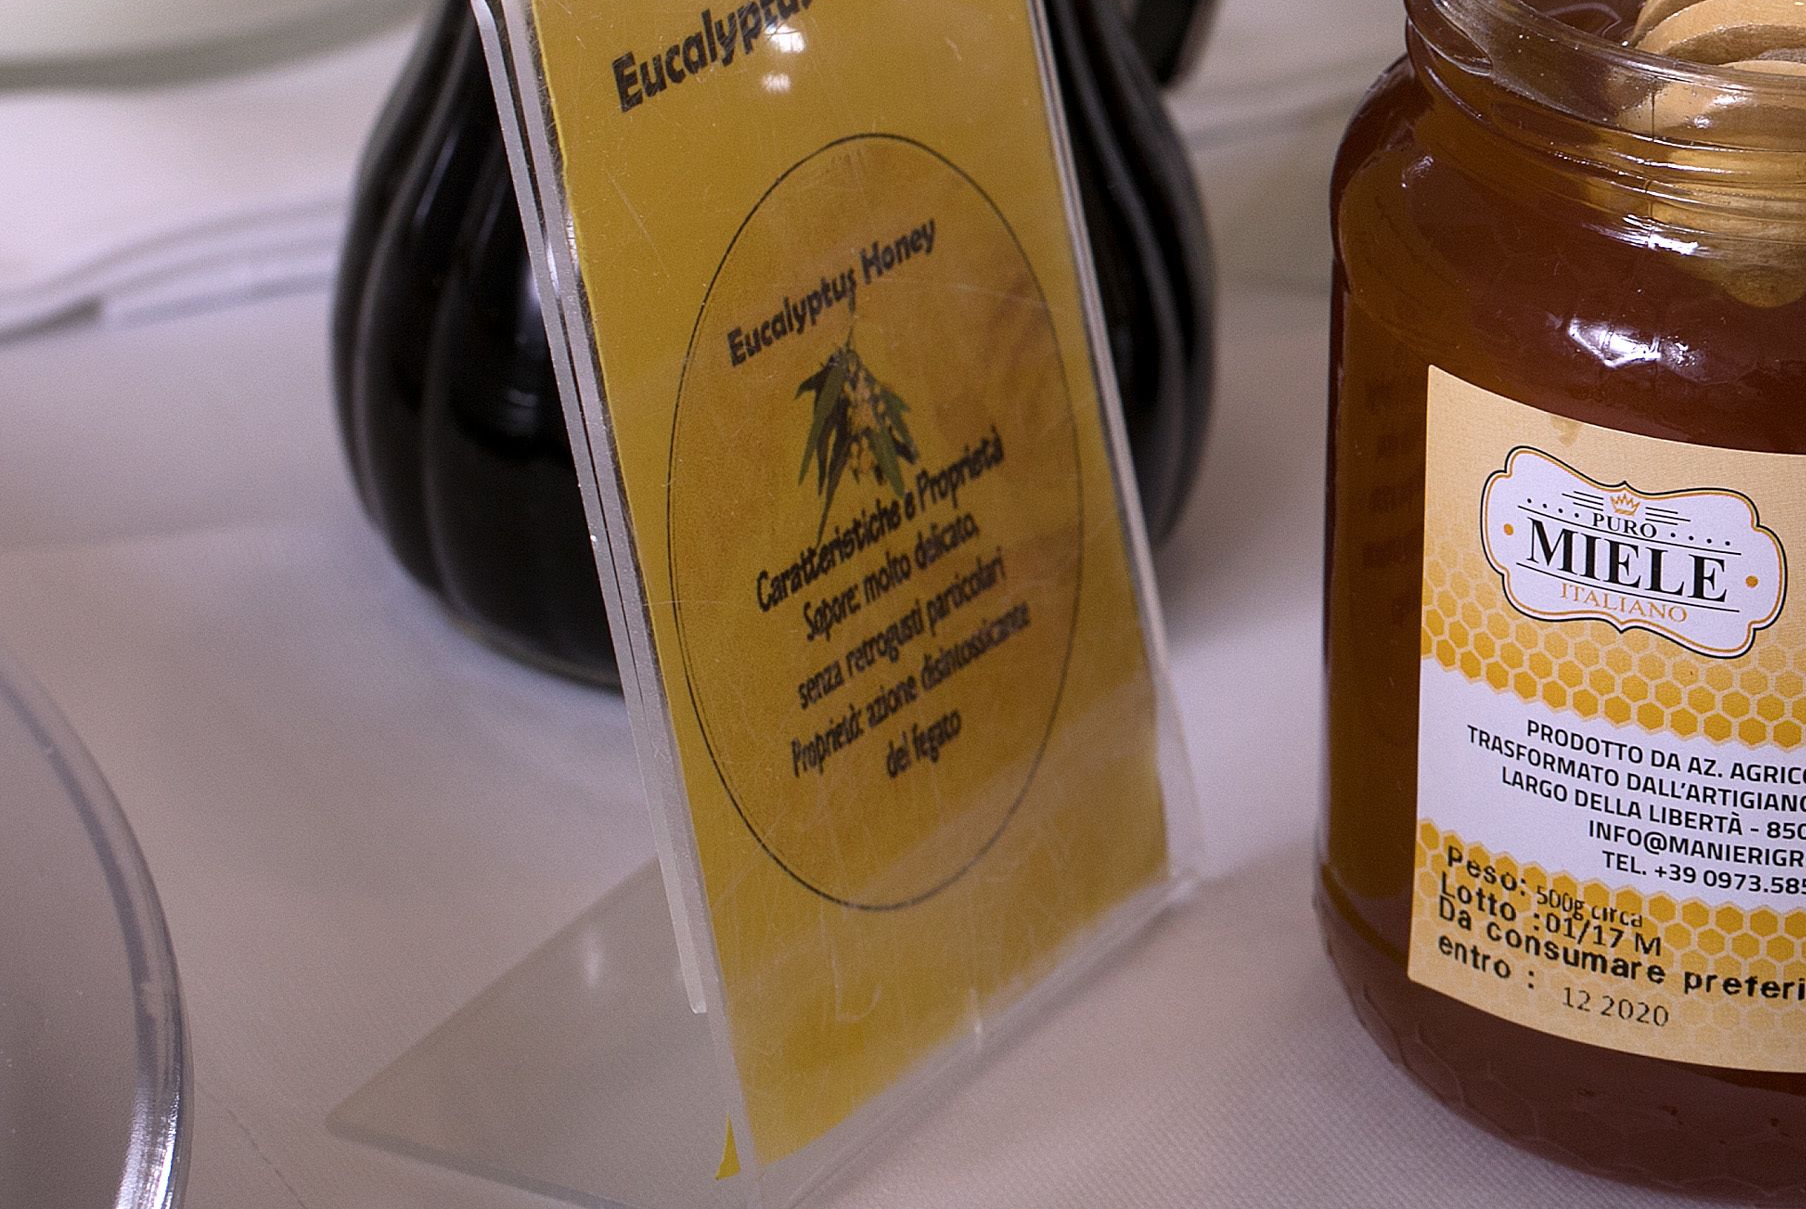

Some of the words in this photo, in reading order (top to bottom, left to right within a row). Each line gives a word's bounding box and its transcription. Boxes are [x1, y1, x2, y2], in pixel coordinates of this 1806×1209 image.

[727, 265, 857, 367] Eucalyptus
[860, 218, 936, 285] Honey
[756, 498, 902, 613] Caratteristiche
[904, 492, 915, 521] e
[916, 424, 1004, 512] Proprietà
[1592, 511, 1658, 539] PURO
[864, 550, 912, 604] molto
[1525, 516, 1730, 603] MIELE
[1559, 582, 1689, 623] ITALIANO
[797, 658, 845, 710] senza
[866, 673, 919, 730] azione
[886, 731, 913, 779] del
[912, 707, 963, 764] fegato
[1466, 724, 1620, 787] TRASFORMATO
[1526, 718, 1644, 764] PRODOTTO
[1649, 749, 1682, 772] DA
[1686, 757, 1724, 779] AZ.
[1500, 765, 1568, 803] LARGO
[1574, 788, 1643, 820] DELLA
[1648, 803, 1744, 837] LIBERTÀ
[1446, 844, 1527, 897] Peso:
[1536, 885, 1586, 921] 500g
[1591, 905, 1643, 928] circa
[1601, 849, 1648, 876] TEL.
[1654, 863, 1697, 884] +39
[1438, 894, 1473, 932] Da
[1486, 920, 1667, 985] consumare
[1441, 870, 1517, 923] Lotto
[1634, 933, 1662, 957] M
[1437, 934, 1512, 980] entro
[1562, 986, 1592, 1013] 12
[1601, 995, 1670, 1028] 2020
